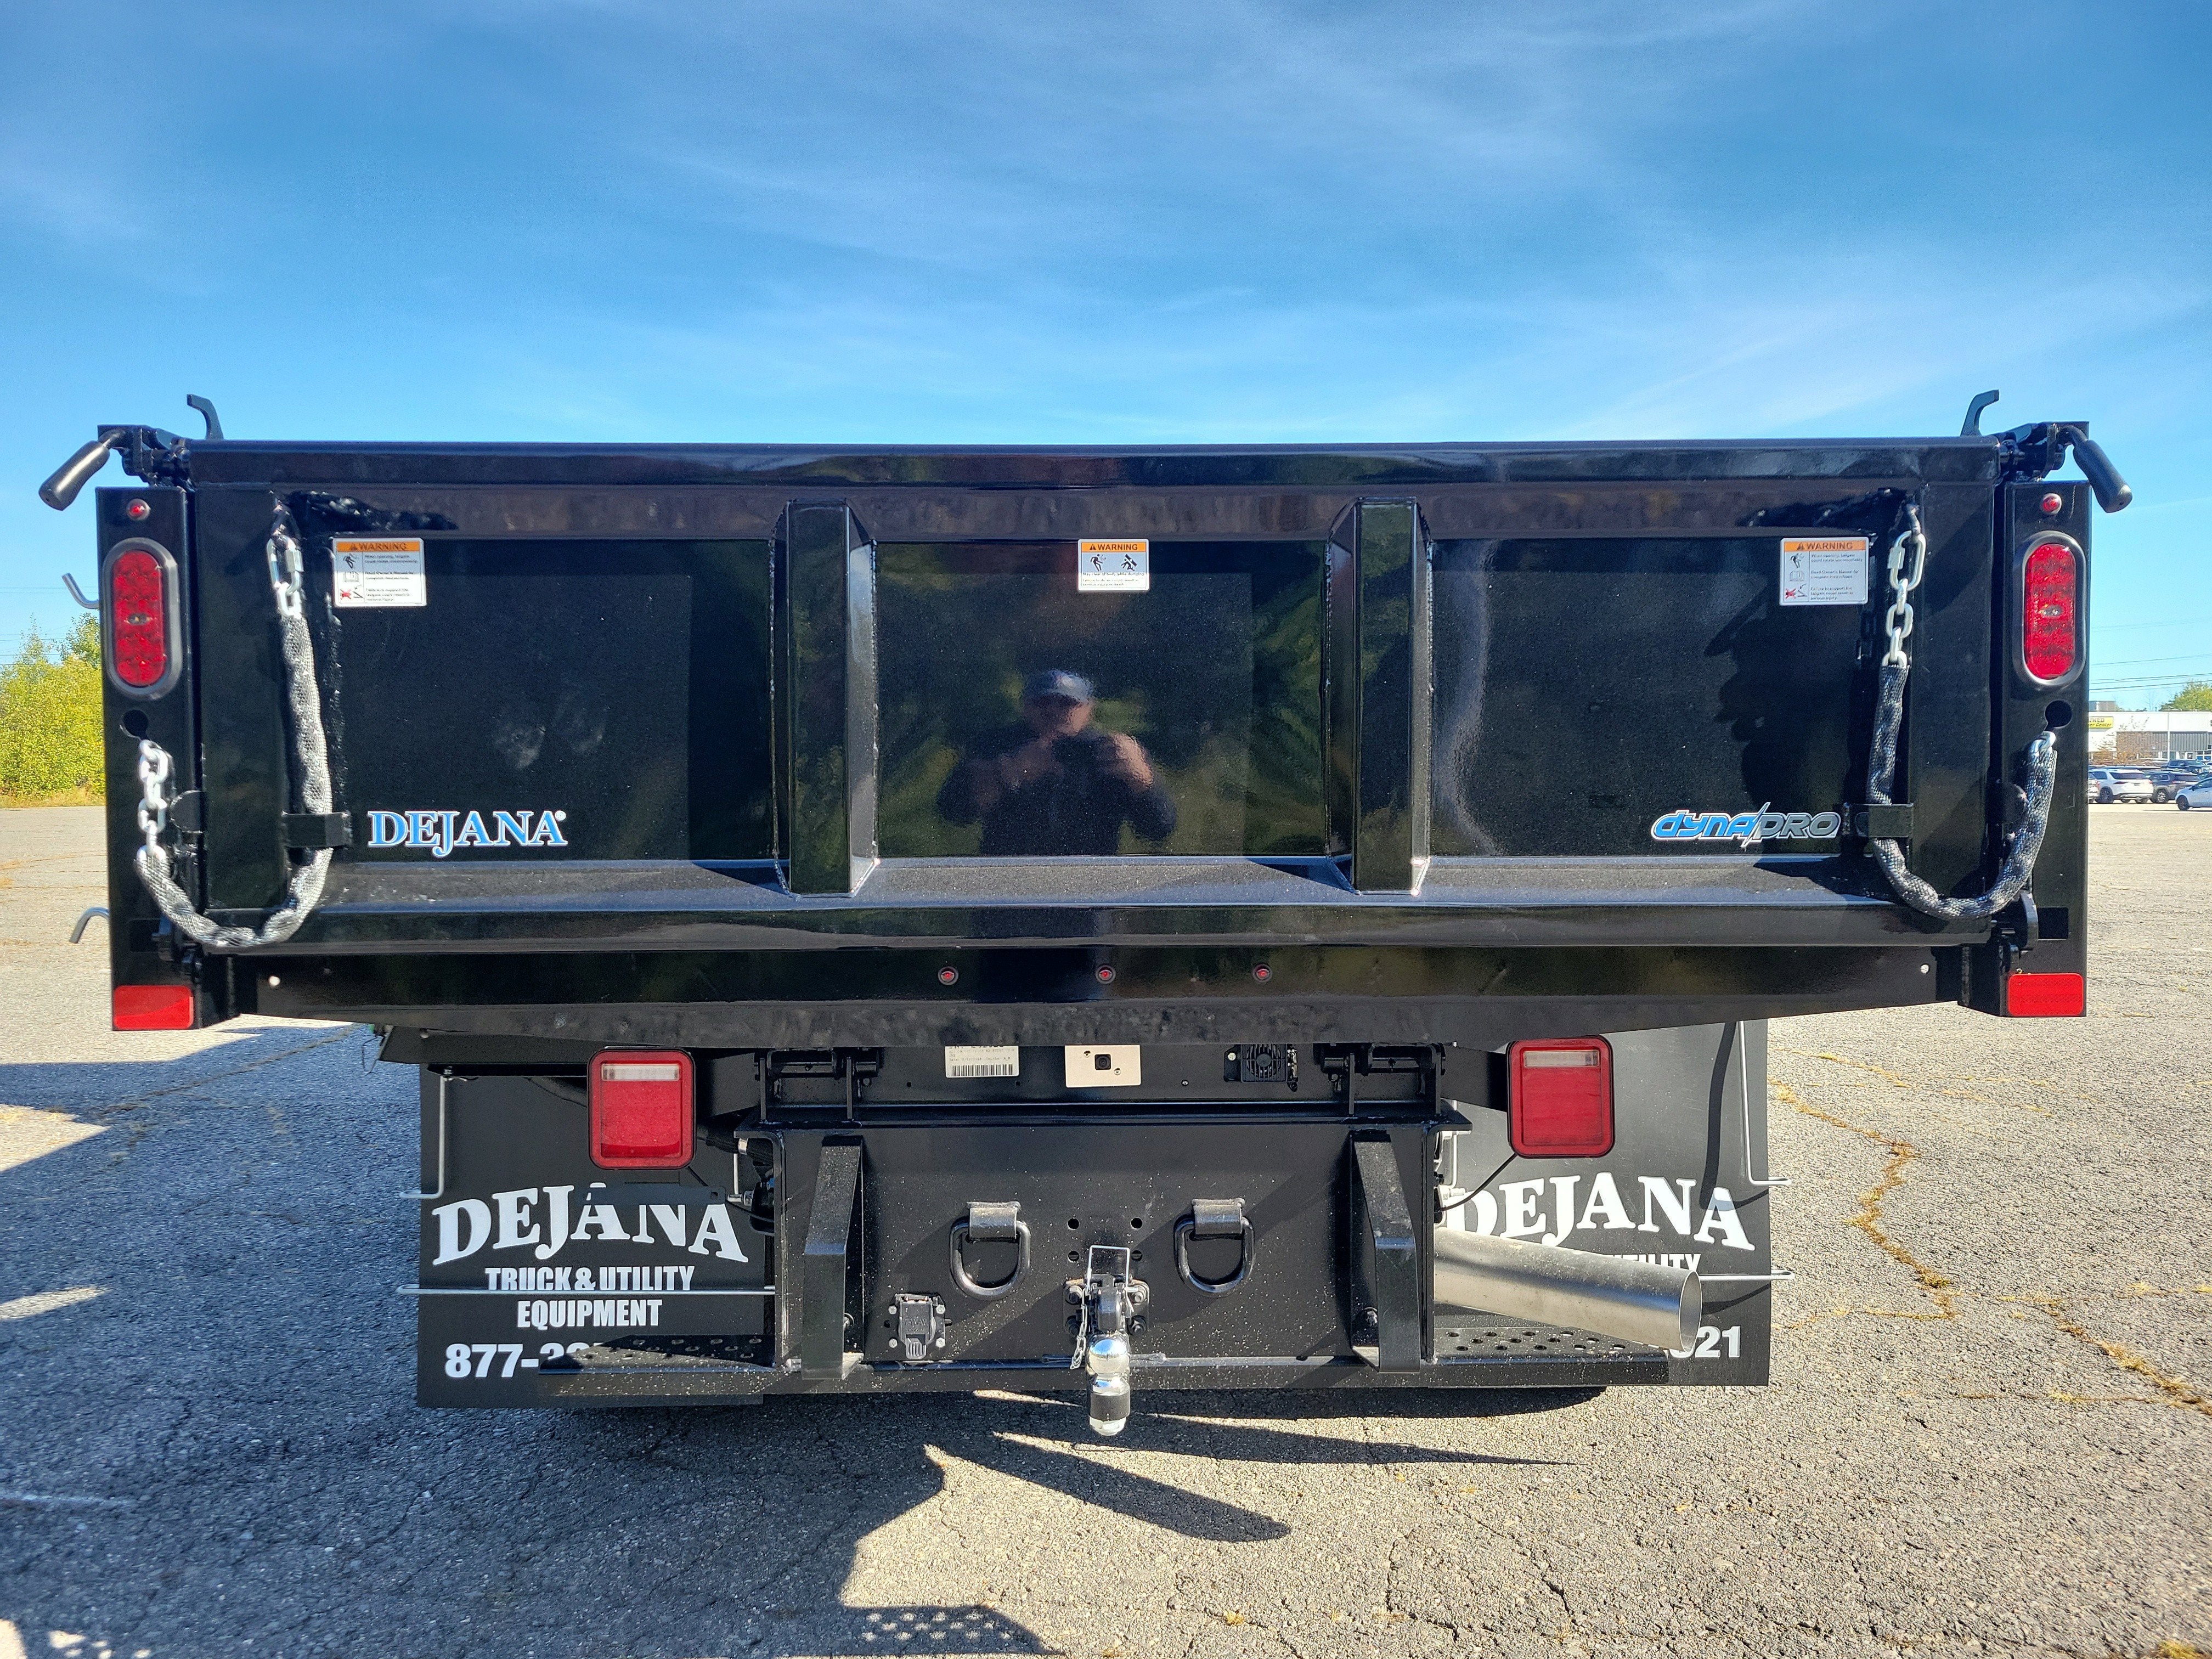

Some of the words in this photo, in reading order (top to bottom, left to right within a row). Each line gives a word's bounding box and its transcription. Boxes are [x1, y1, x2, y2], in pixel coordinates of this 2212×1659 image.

[368, 811, 568, 857] DEJANA
[432, 1183, 749, 1265] DEJANA
[1446, 1172, 1755, 1251] DEJANA
[517, 1299, 663, 1330] EQUIPMENT
[1669, 1325, 1741, 1358] 21
